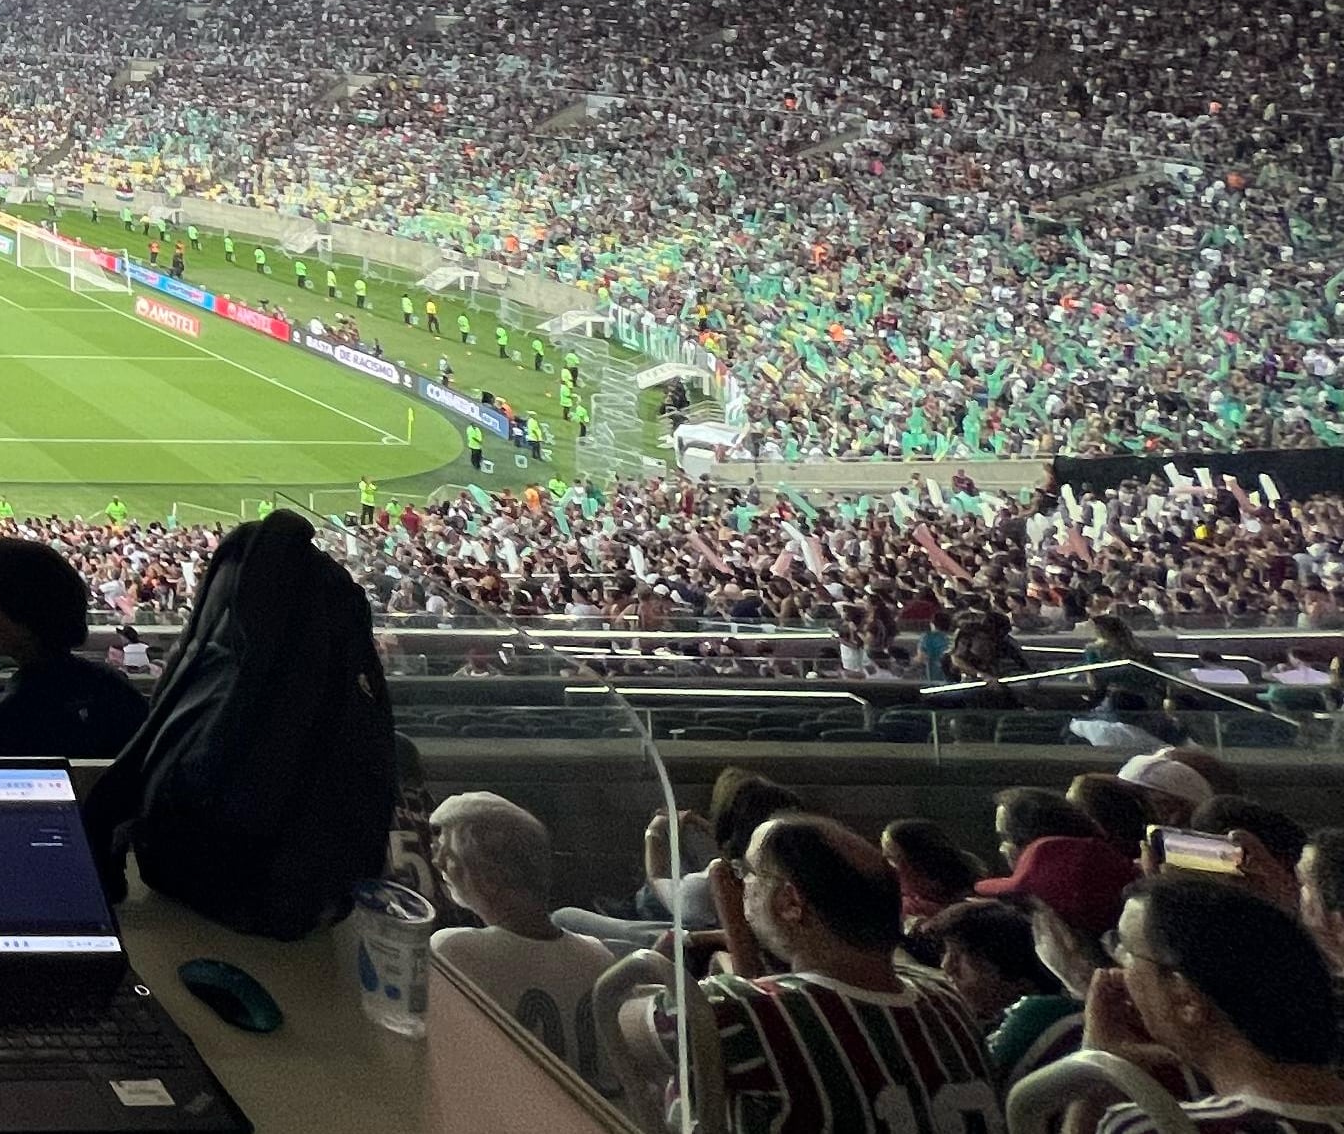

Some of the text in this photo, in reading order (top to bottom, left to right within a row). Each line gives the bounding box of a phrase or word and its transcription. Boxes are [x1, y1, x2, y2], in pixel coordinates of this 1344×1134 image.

[148, 302, 198, 337] AMSTEL
[237, 307, 272, 334] AMSTEL
[353, 349, 394, 378] RACISMO
